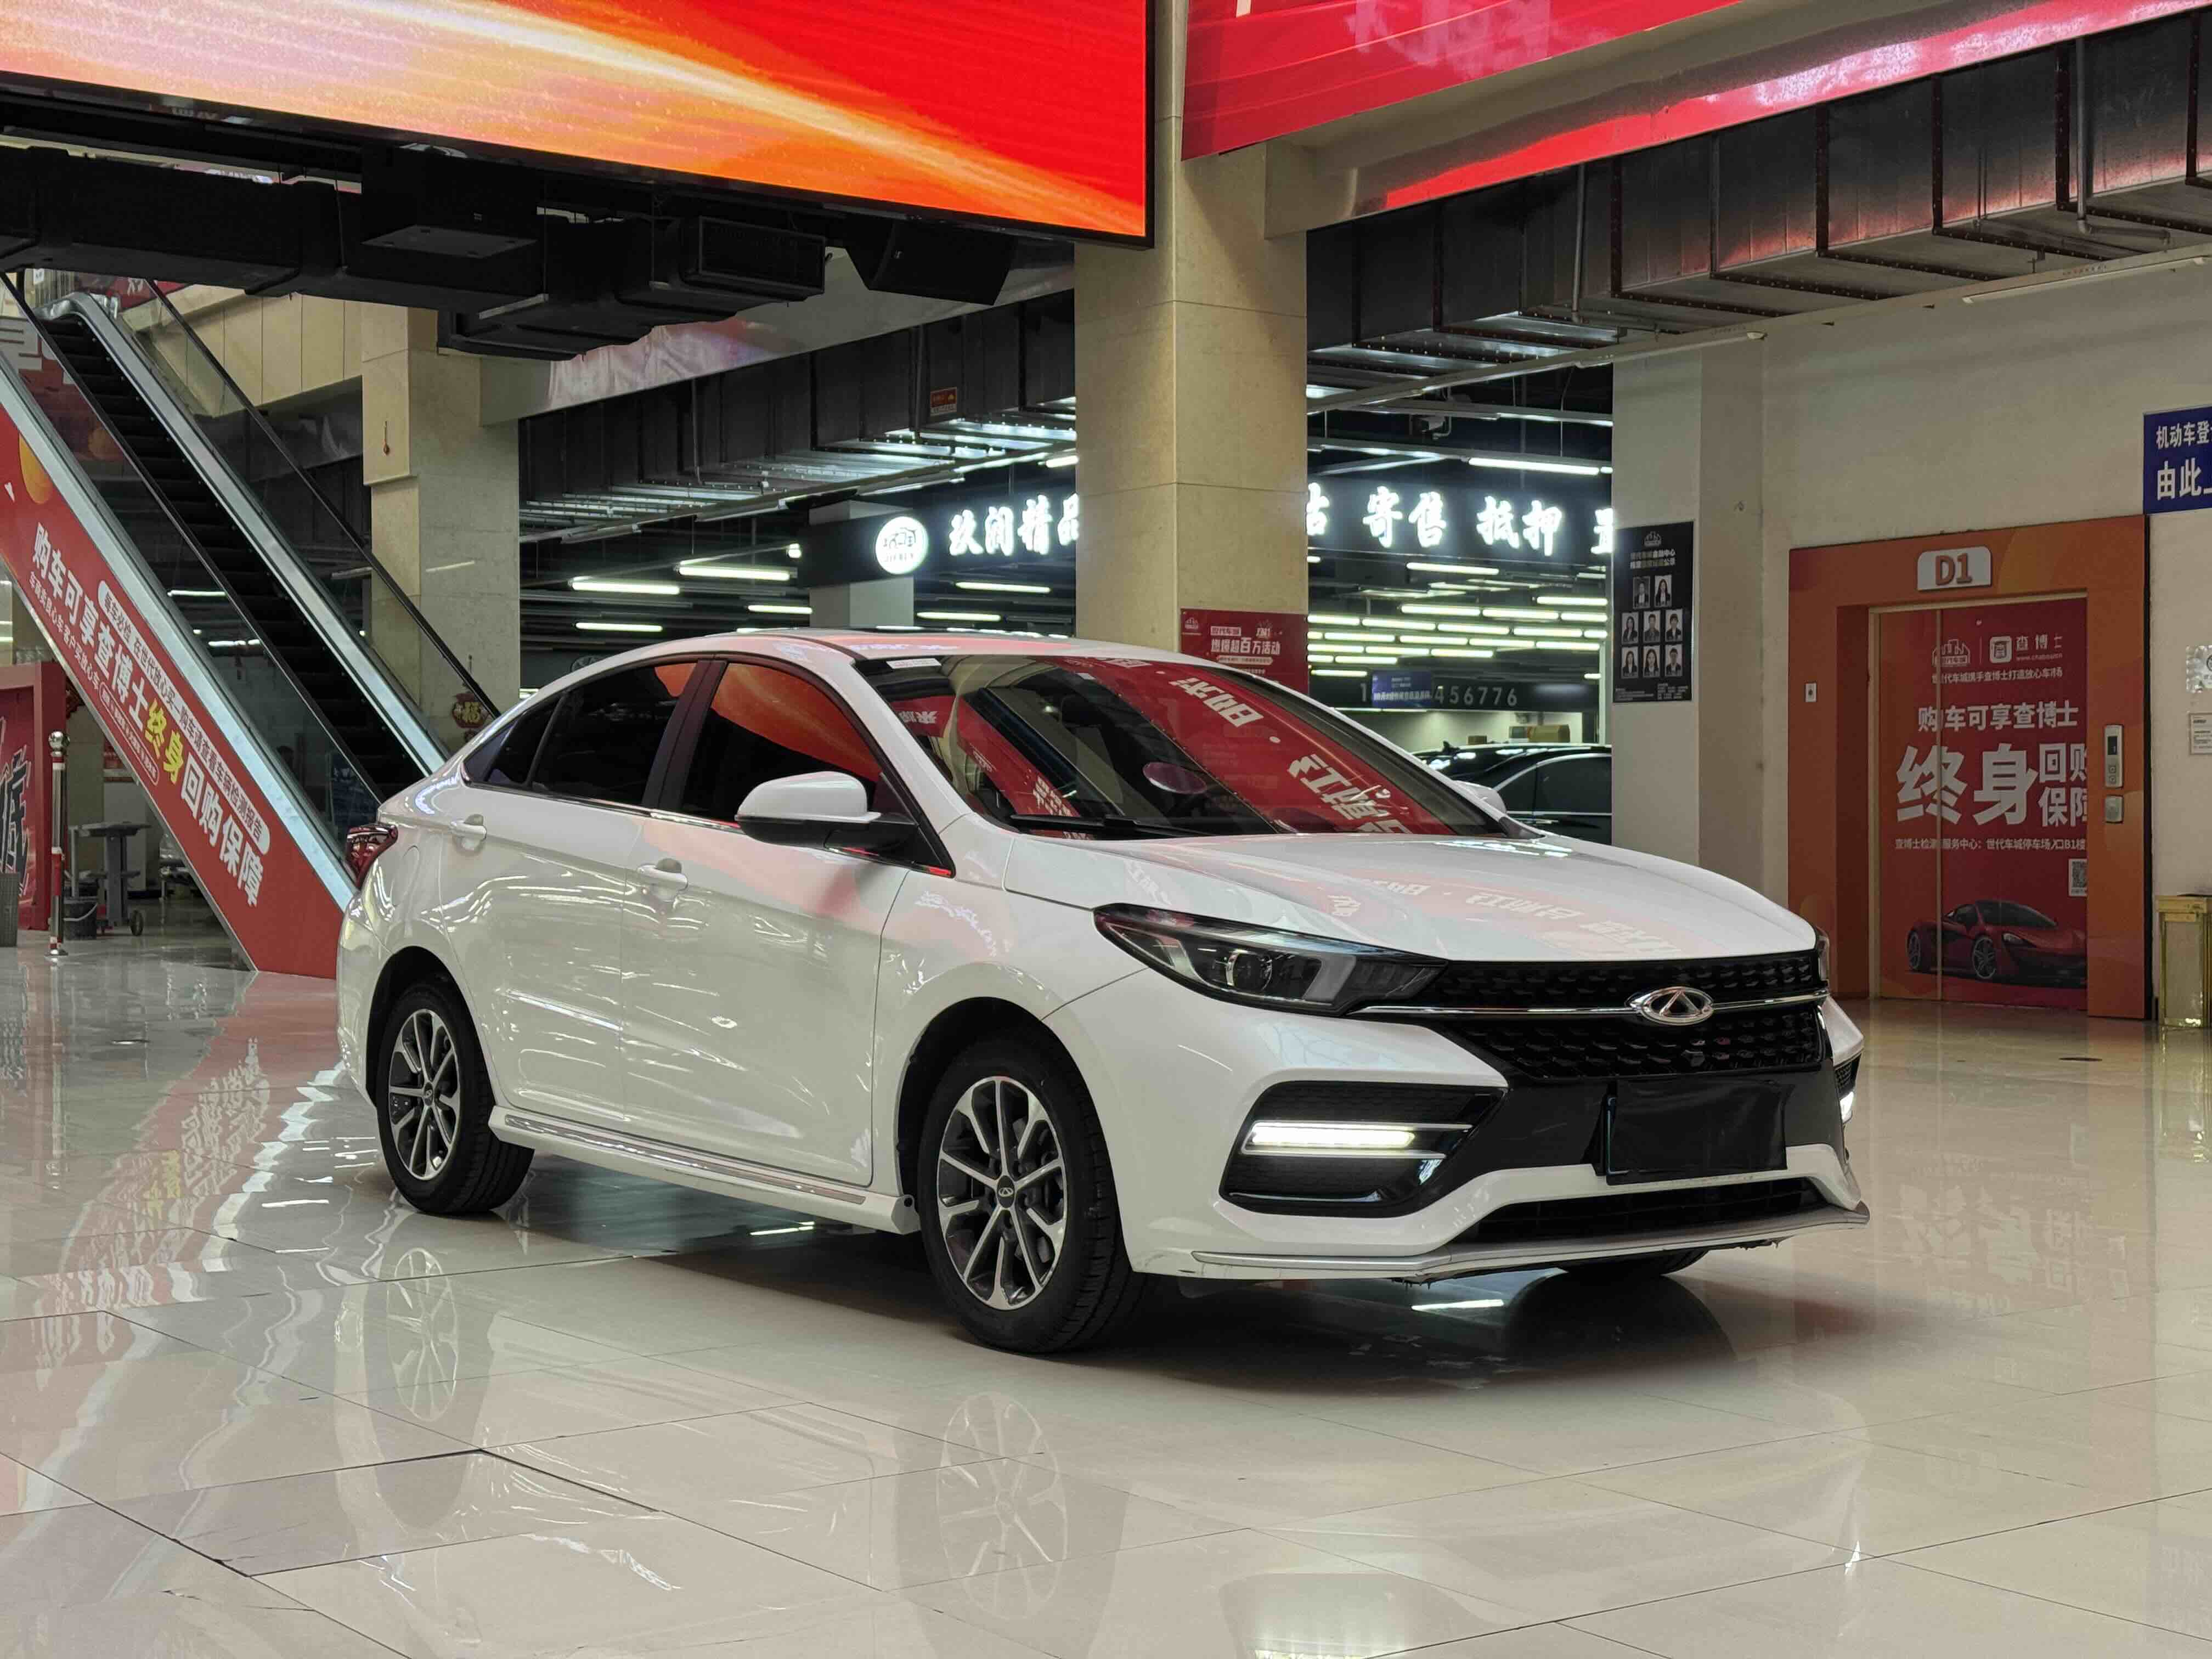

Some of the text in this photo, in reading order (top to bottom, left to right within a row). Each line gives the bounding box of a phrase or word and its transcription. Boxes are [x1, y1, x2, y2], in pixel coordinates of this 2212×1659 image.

[2155, 420, 2212, 449] 机动车登
[1363, 486, 1447, 548] 寄售
[1476, 495, 1562, 556] 抵押
[1935, 553, 1973, 586] D1
[1918, 699, 2079, 732] 购车可享查博士
[1896, 743, 2039, 826] 终身
